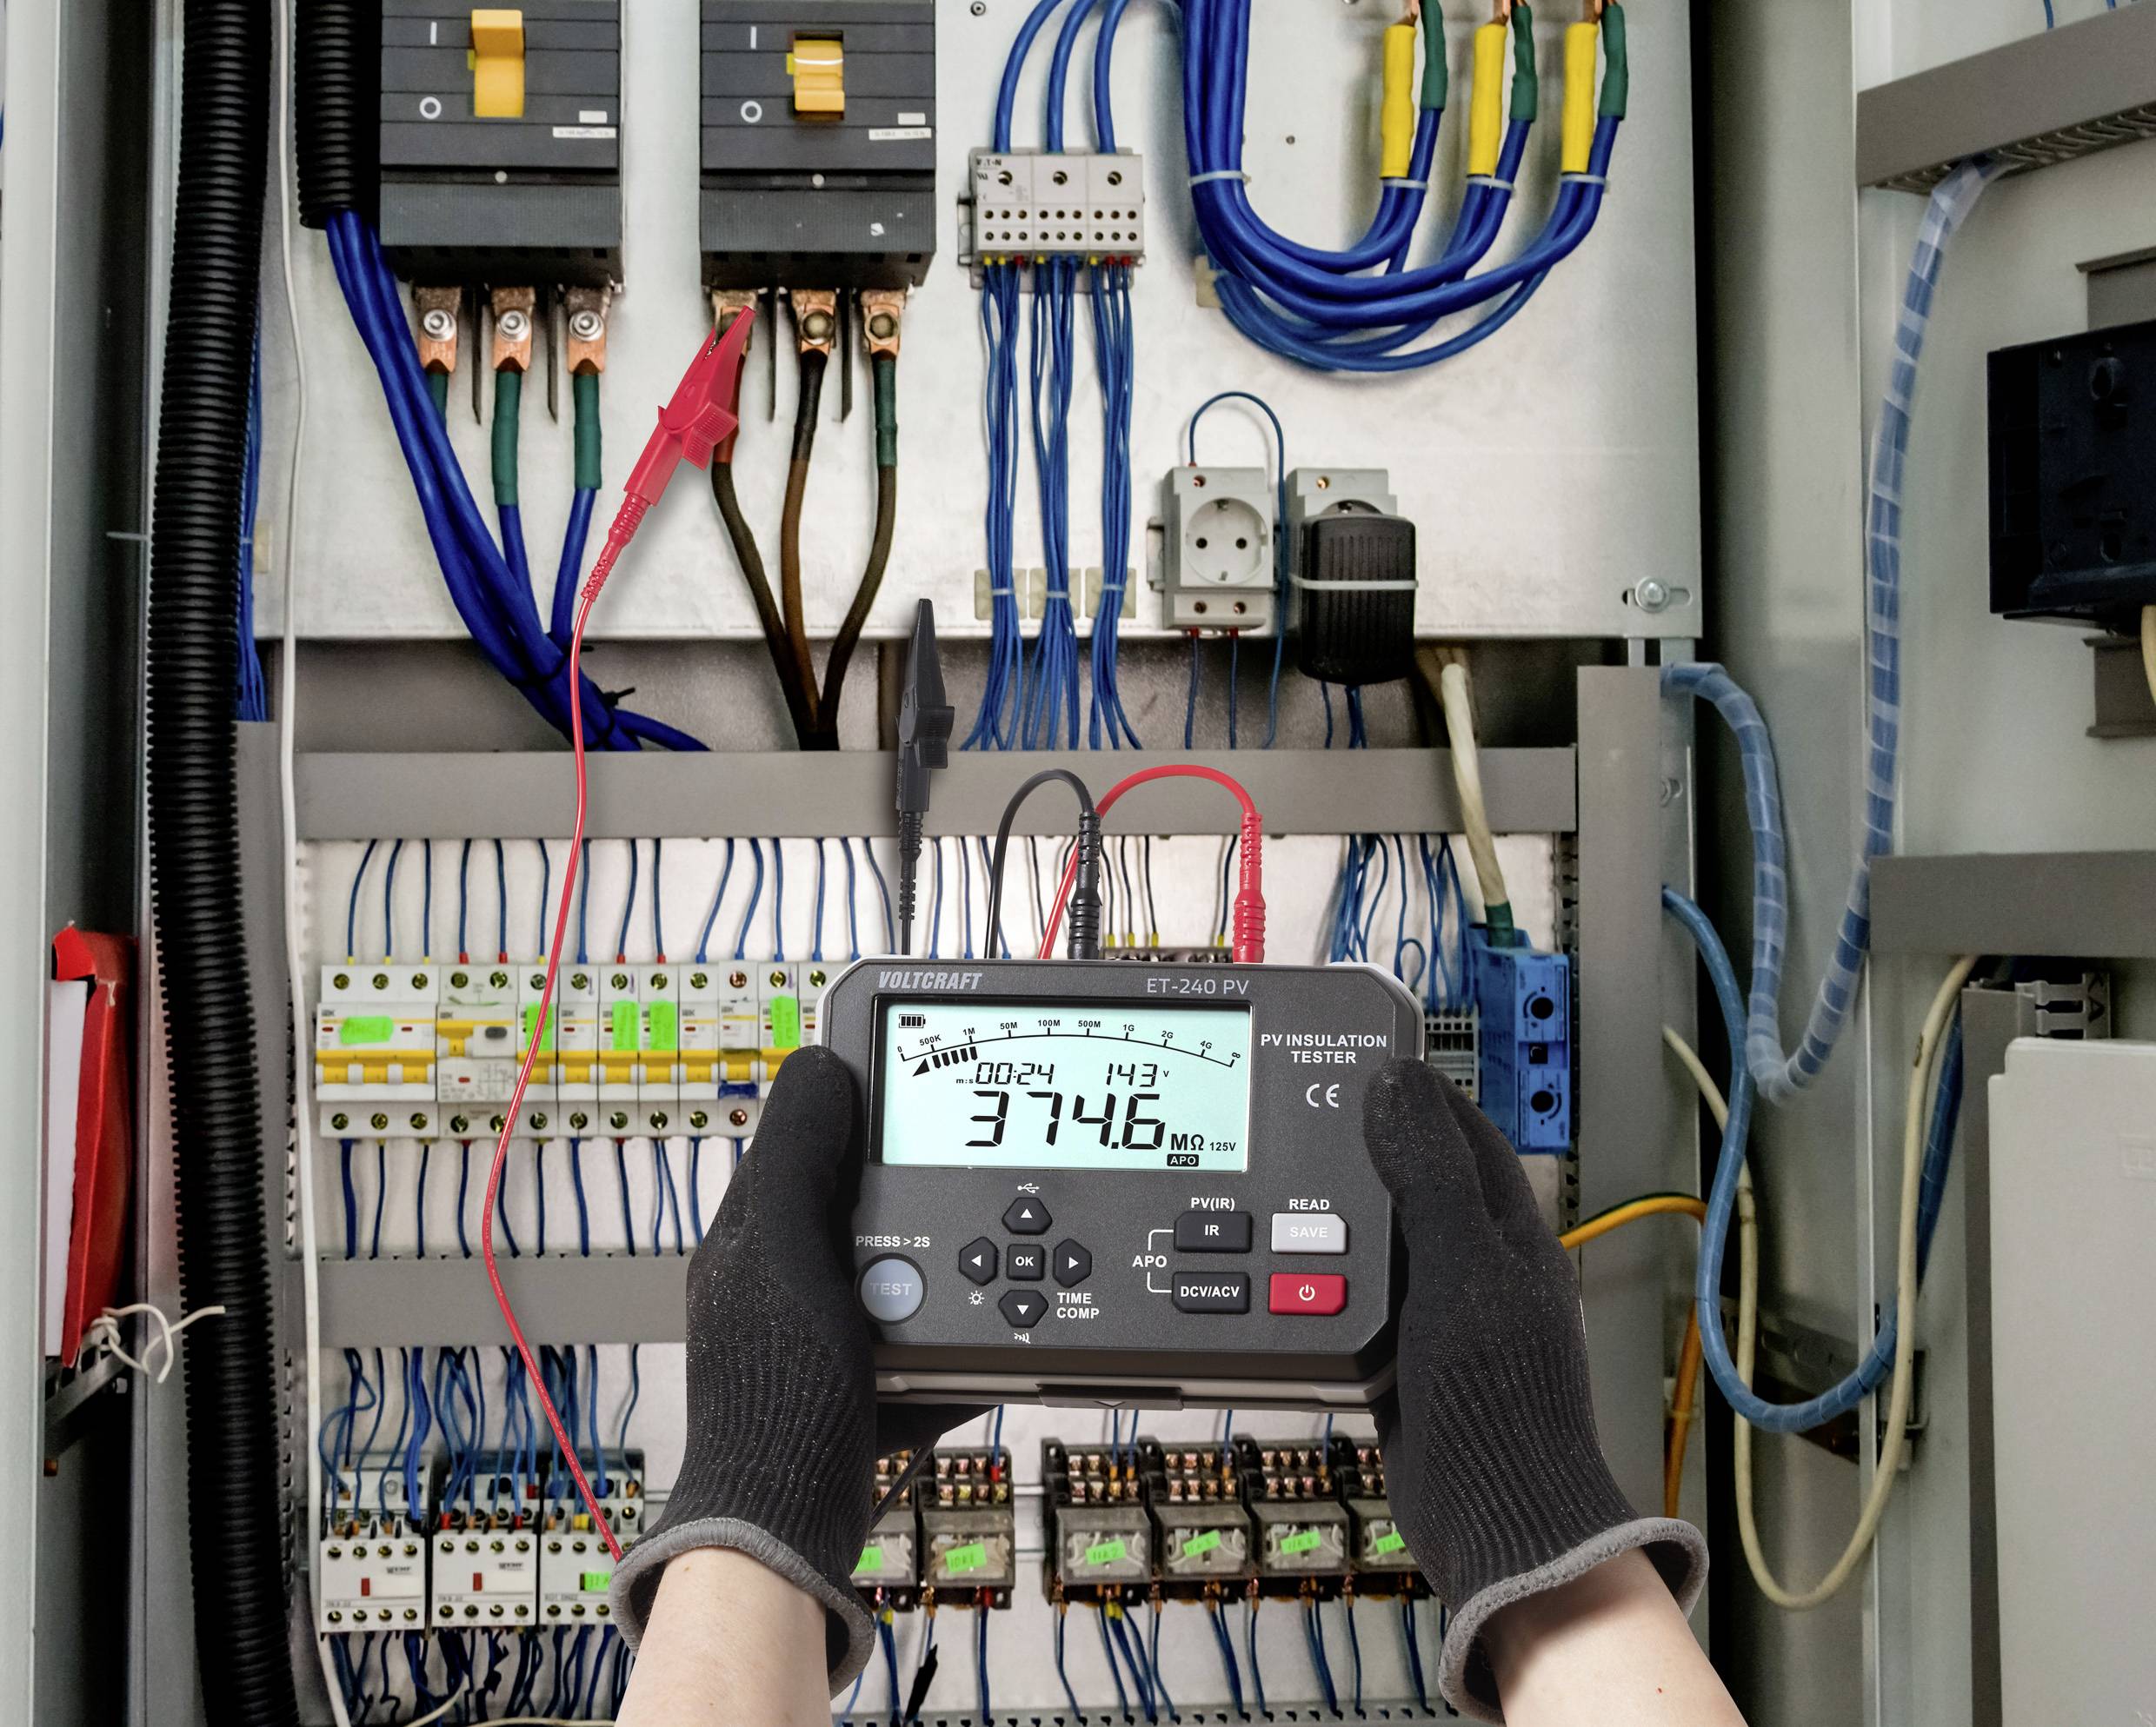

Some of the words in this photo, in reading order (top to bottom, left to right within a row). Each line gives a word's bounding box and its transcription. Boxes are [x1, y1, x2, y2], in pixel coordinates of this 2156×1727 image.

[878, 971, 982, 990] VOLTCRAFT
[1147, 978, 1216, 994] ET-240
[1223, 980, 1249, 995] PV
[919, 1033, 942, 1046] 500K
[962, 1027, 975, 1036] 1M
[1000, 1021, 1018, 1030] 50M
[1037, 1019, 1061, 1027] 100M
[1078, 1020, 1101, 1028] 500M
[1161, 1030, 1174, 1039] 2G
[1200, 1040, 1213, 1050] 4G
[1261, 1033, 1283, 1046] PV
[1287, 1034, 1387, 1047] INSULATION
[1290, 1050, 1356, 1064] TESTER
[975, 1062, 1055, 1085] 00:24
[1106, 1063, 1158, 1087] 143
[1306, 1083, 1340, 1108] CE
[965, 1090, 1166, 1150] 374.6
[1171, 1133, 1204, 1151] MΩ
[1209, 1141, 1237, 1152] 125V
[1170, 1155, 1196, 1166] APO
[1191, 1197, 1235, 1212] PV(IR)
[1289, 1199, 1330, 1211] READ
[1204, 1225, 1220, 1236] IR
[1289, 1226, 1328, 1238] SAVE
[855, 1236, 901, 1247] PRESS
[913, 1236, 930, 1247] 2S
[1015, 1256, 1034, 1266] OK
[1132, 1255, 1168, 1268] APO
[869, 1283, 913, 1296] TEST
[1181, 1286, 1240, 1299] DCV/ACV
[1057, 1292, 1092, 1304] TIME
[1056, 1306, 1100, 1319] COMP
